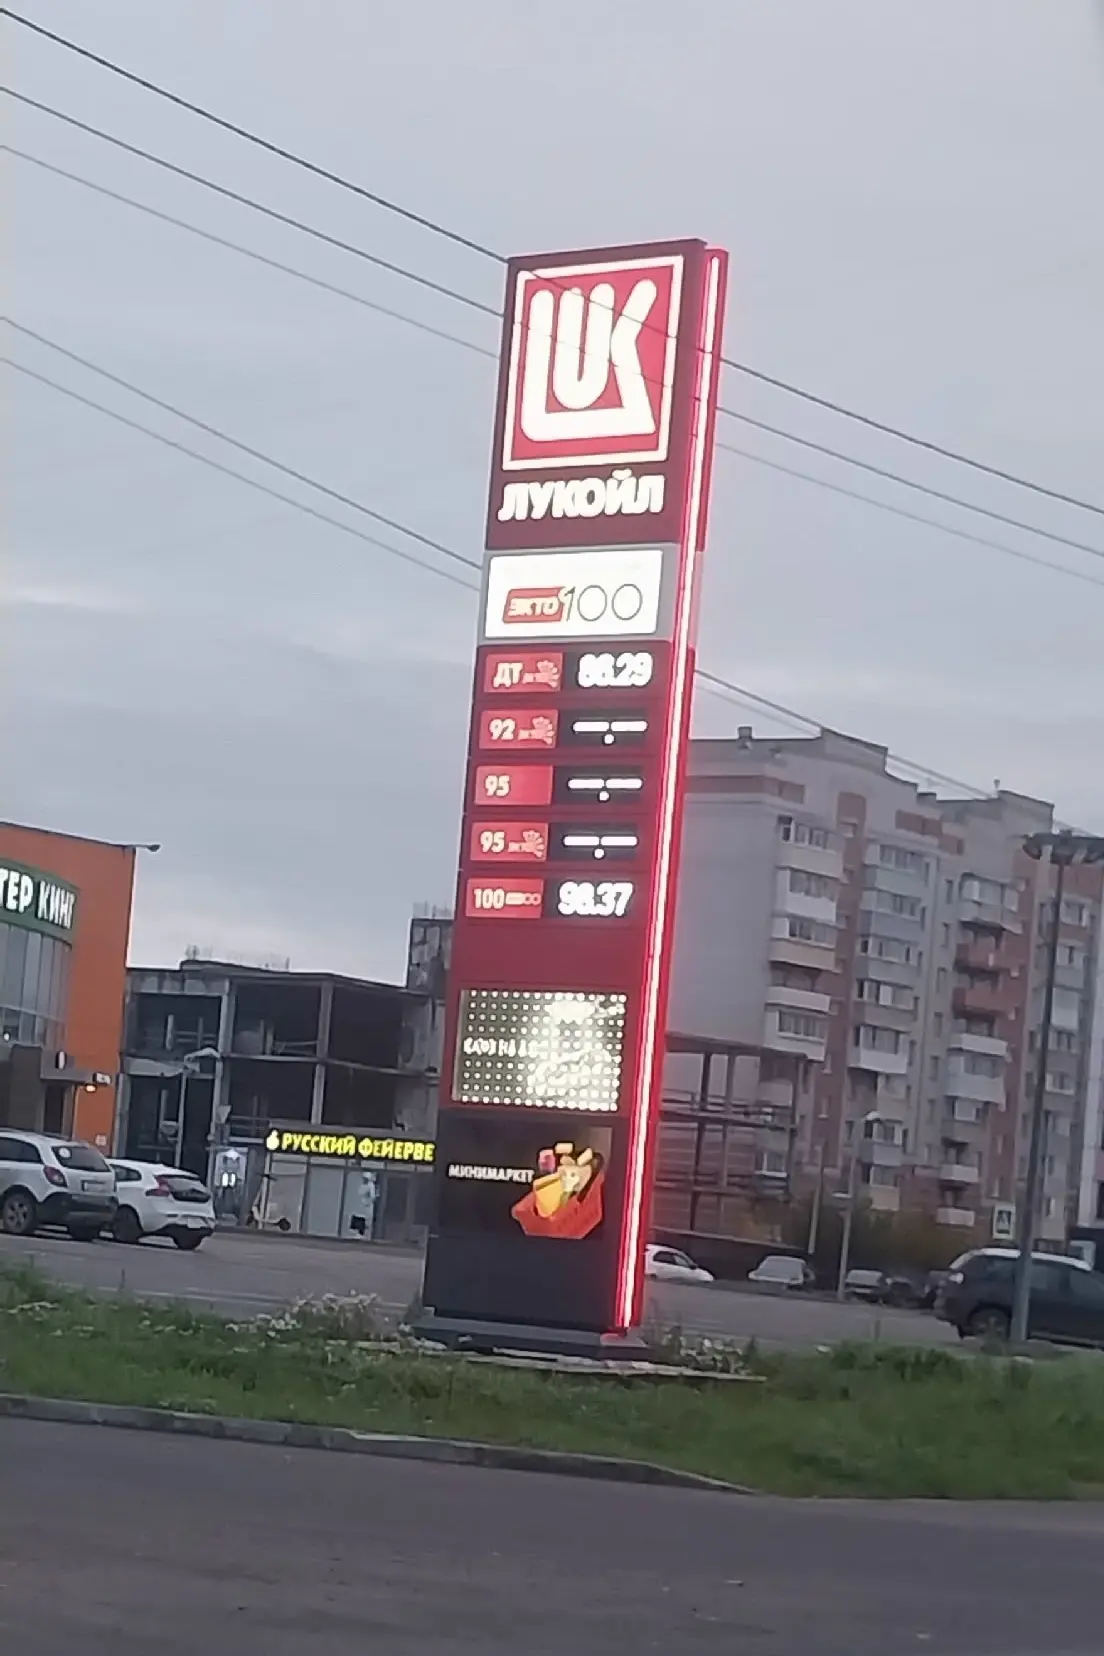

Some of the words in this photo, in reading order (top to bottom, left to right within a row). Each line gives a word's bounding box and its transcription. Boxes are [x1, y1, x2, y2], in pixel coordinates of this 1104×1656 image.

[496, 469, 665, 522] ЛУКОЙЛ
[507, 595, 560, 617] ЭКТО
[563, 583, 643, 622] 100
[493, 662, 524, 688] ДТ
[489, 718, 516, 741] 92
[484, 775, 510, 797] 95
[480, 831, 506, 853] 95
[473, 888, 505, 910] 100
[281, 1132, 356, 1156] РУССКИЙ
[358, 1138, 436, 1162] ФЕЙЕРВЕ
[448, 1164, 535, 1184] МИНИМАРКЕТ
